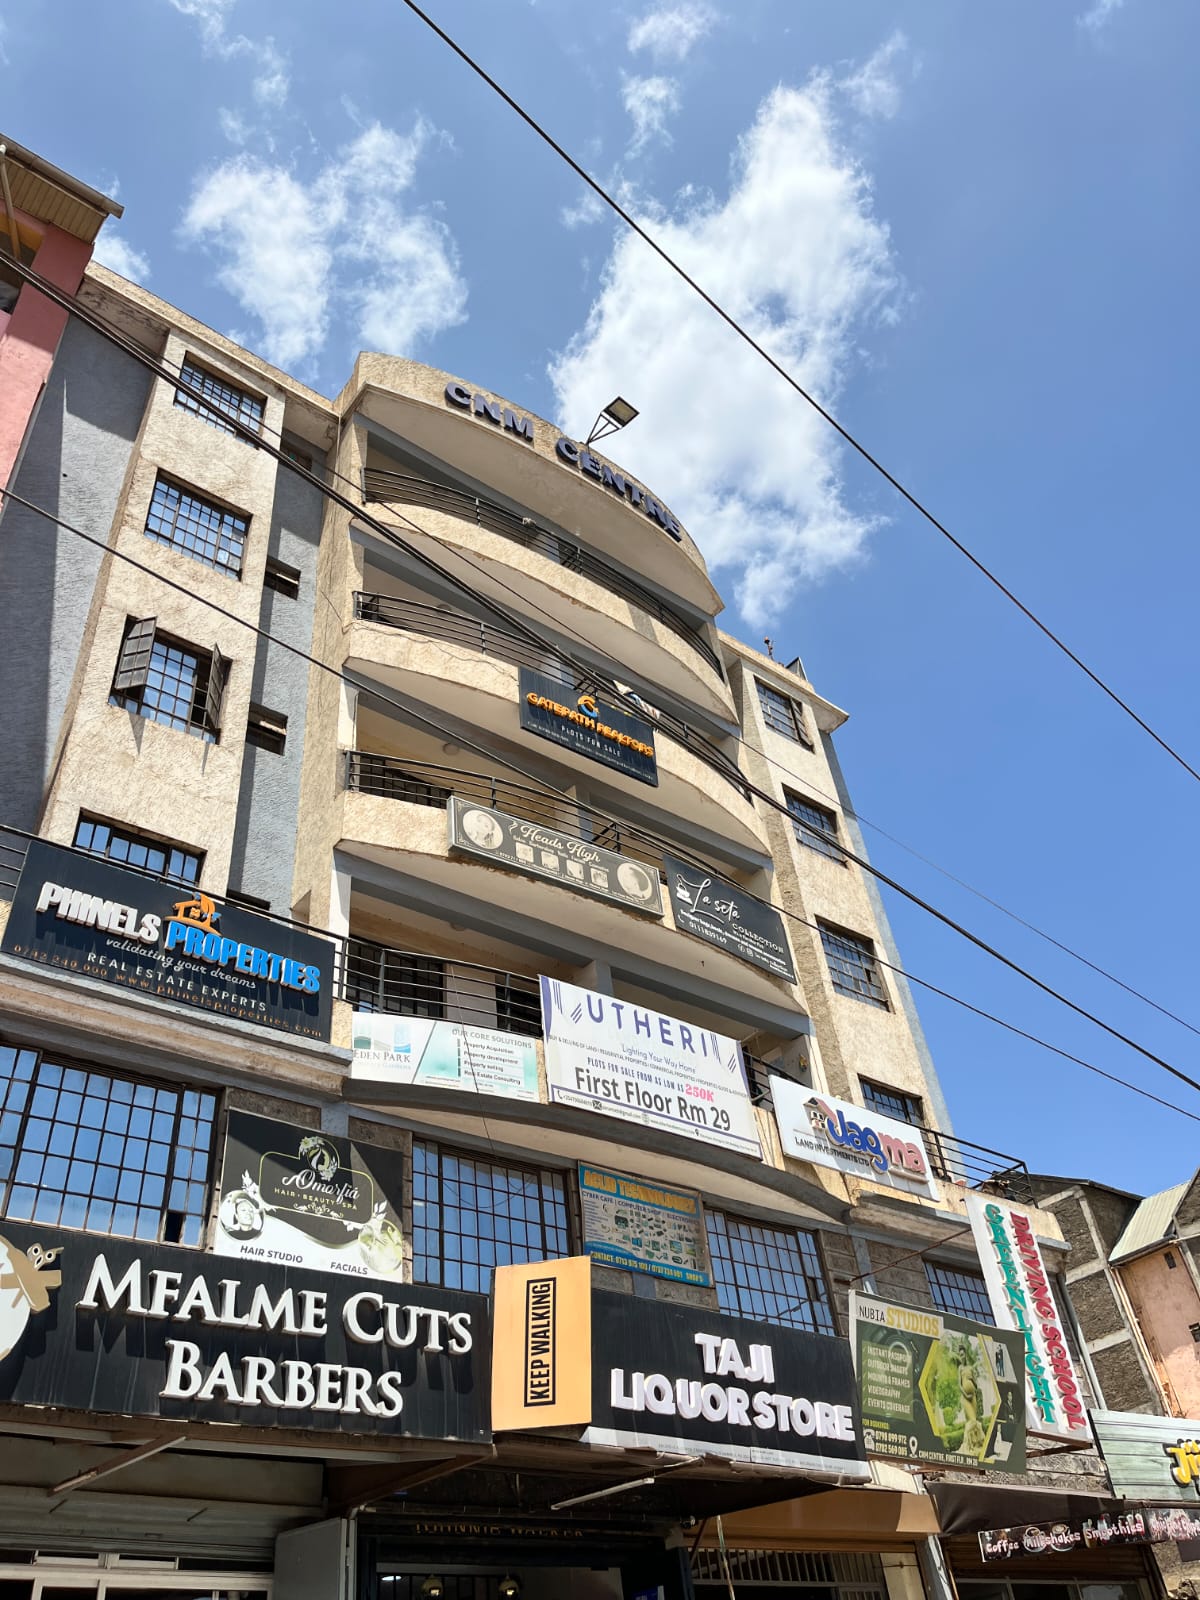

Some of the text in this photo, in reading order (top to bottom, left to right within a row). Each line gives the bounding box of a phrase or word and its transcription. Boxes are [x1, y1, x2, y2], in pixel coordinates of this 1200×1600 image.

[445, 382, 682, 542] CNM CENTRE
[526, 692, 595, 730] GATEPATH
[596, 722, 654, 757] REALTORS
[520, 823, 564, 850] Heads
[566, 839, 601, 864] High
[36, 881, 320, 994] PHINELS PROPERTIES
[732, 922, 784, 954] COLLECTION
[105, 937, 257, 990] validating your dreams
[87, 952, 267, 1012] REAL ESTATE EXPERTS
[452, 1028, 532, 1050] OUR CORE SOLUTIONS
[622, 1043, 649, 1061] Lighting
[353, 1049, 411, 1064] EDEN PARK
[477, 1071, 493, 1080] Estate
[621, 1065, 635, 1079] SALE
[637, 1070, 653, 1084] FROM
[685, 1084, 715, 1102] 250K
[575, 1066, 621, 1100] First
[625, 1080, 672, 1115] Floor
[677, 1095, 708, 1125] Rm
[710, 1106, 731, 1131] 29
[794, 1137, 814, 1150] LAND
[274, 1187, 358, 1211] HAIR BEAUTY SPA
[618, 1200, 647, 1213] COMPUTER
[240, 1244, 265, 1257] HAIR
[267, 1250, 304, 1264] STUDIO
[330, 1261, 368, 1275] FACIALS
[75, 1253, 474, 1354] MFALME CUTS
[859, 1305, 941, 1338] NUBIA STUDIOS
[1010, 1211, 1087, 1430] DRIVING SCHOOL
[530, 1281, 552, 1401] KEEP WALKING
[694, 1332, 775, 1384] TAJI
[159, 1338, 403, 1419] BARBERS
[867, 1384, 901, 1399] VIDEOGRAPHY
[892, 1376, 911, 1388] FRAMES
[610, 1367, 856, 1441] LIQUOR STORE
[867, 1397, 911, 1414] EVENTS COVERAGE
[985, 1539, 1020, 1553] Coffee
[1025, 1531, 1081, 1550] Milkshakes
[1085, 1521, 1143, 1541] Smoothies
